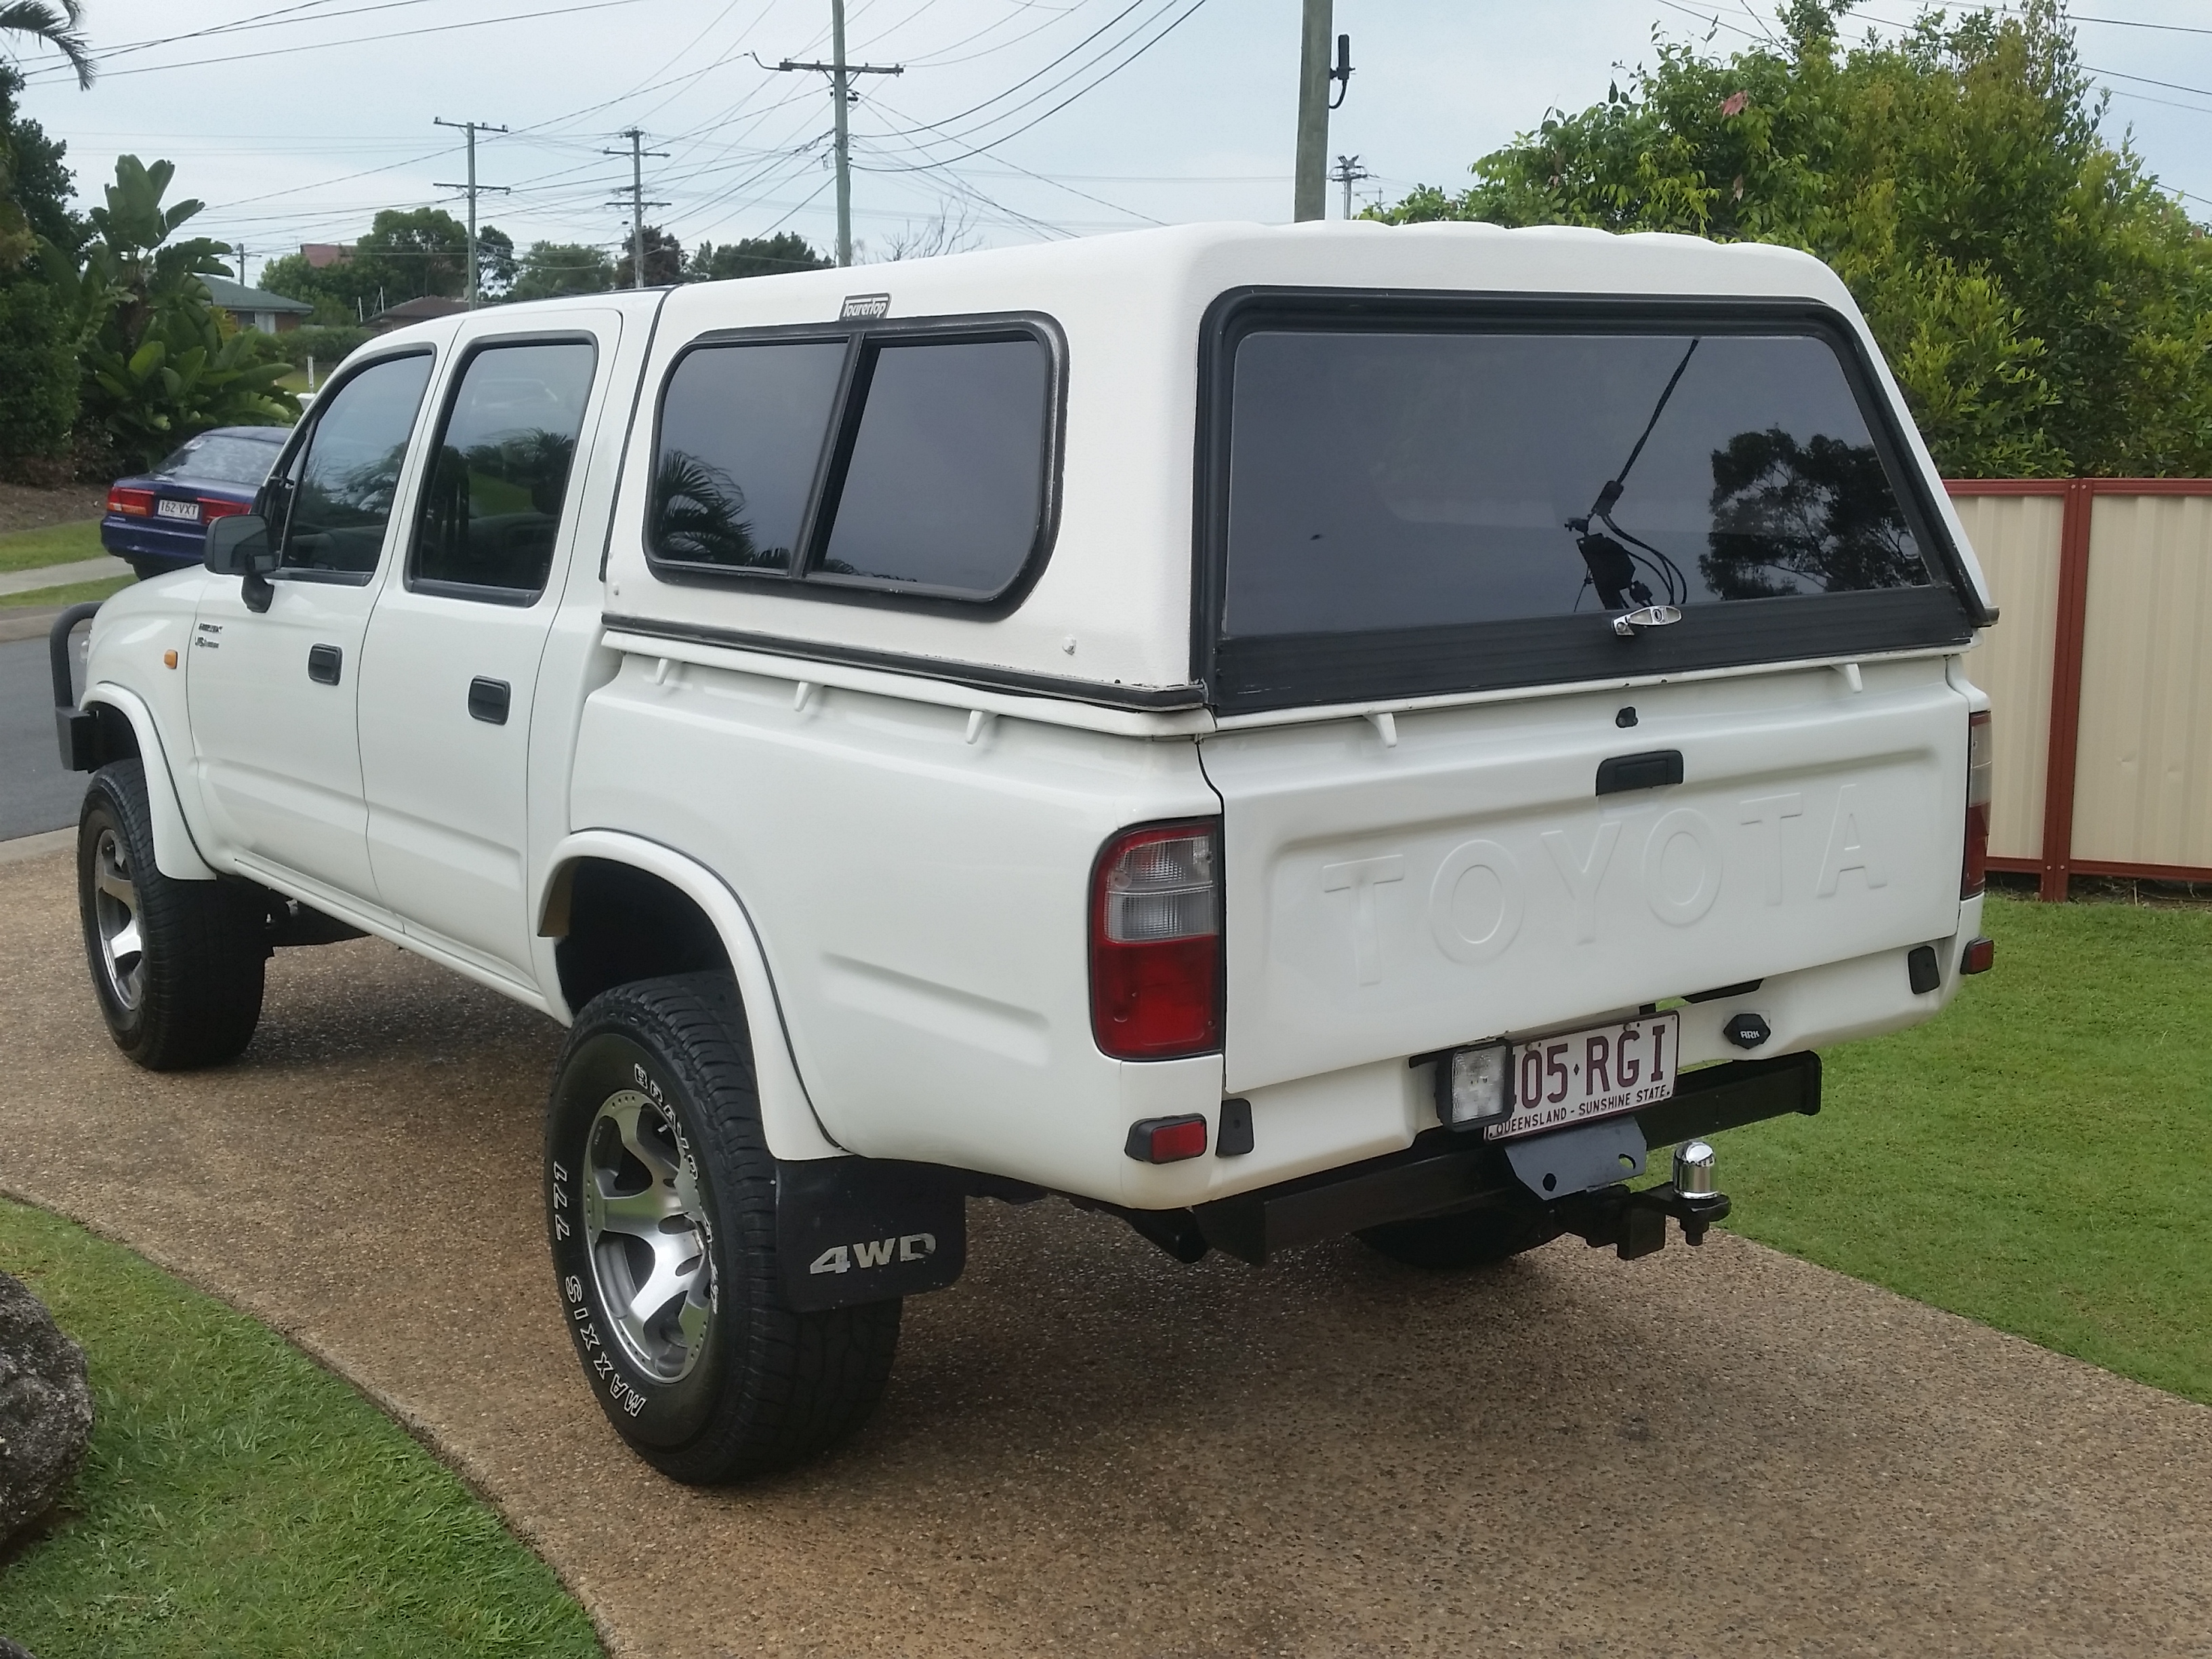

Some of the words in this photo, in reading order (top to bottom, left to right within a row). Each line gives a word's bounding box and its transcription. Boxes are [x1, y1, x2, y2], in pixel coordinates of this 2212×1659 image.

[842, 297, 888, 319] TourerTop
[1322, 784, 1887, 986] TOYOTA
[1740, 1030, 1760, 1039] ARK
[1496, 1107, 1567, 1134] QUEENSLAND
[1579, 1093, 1631, 1116] SUNSHINE
[1636, 1084, 1666, 1103] STATE
[553, 1161, 570, 1241] 771
[810, 1232, 936, 1274] 4WD
[565, 1275, 647, 1417] MAXXIS
